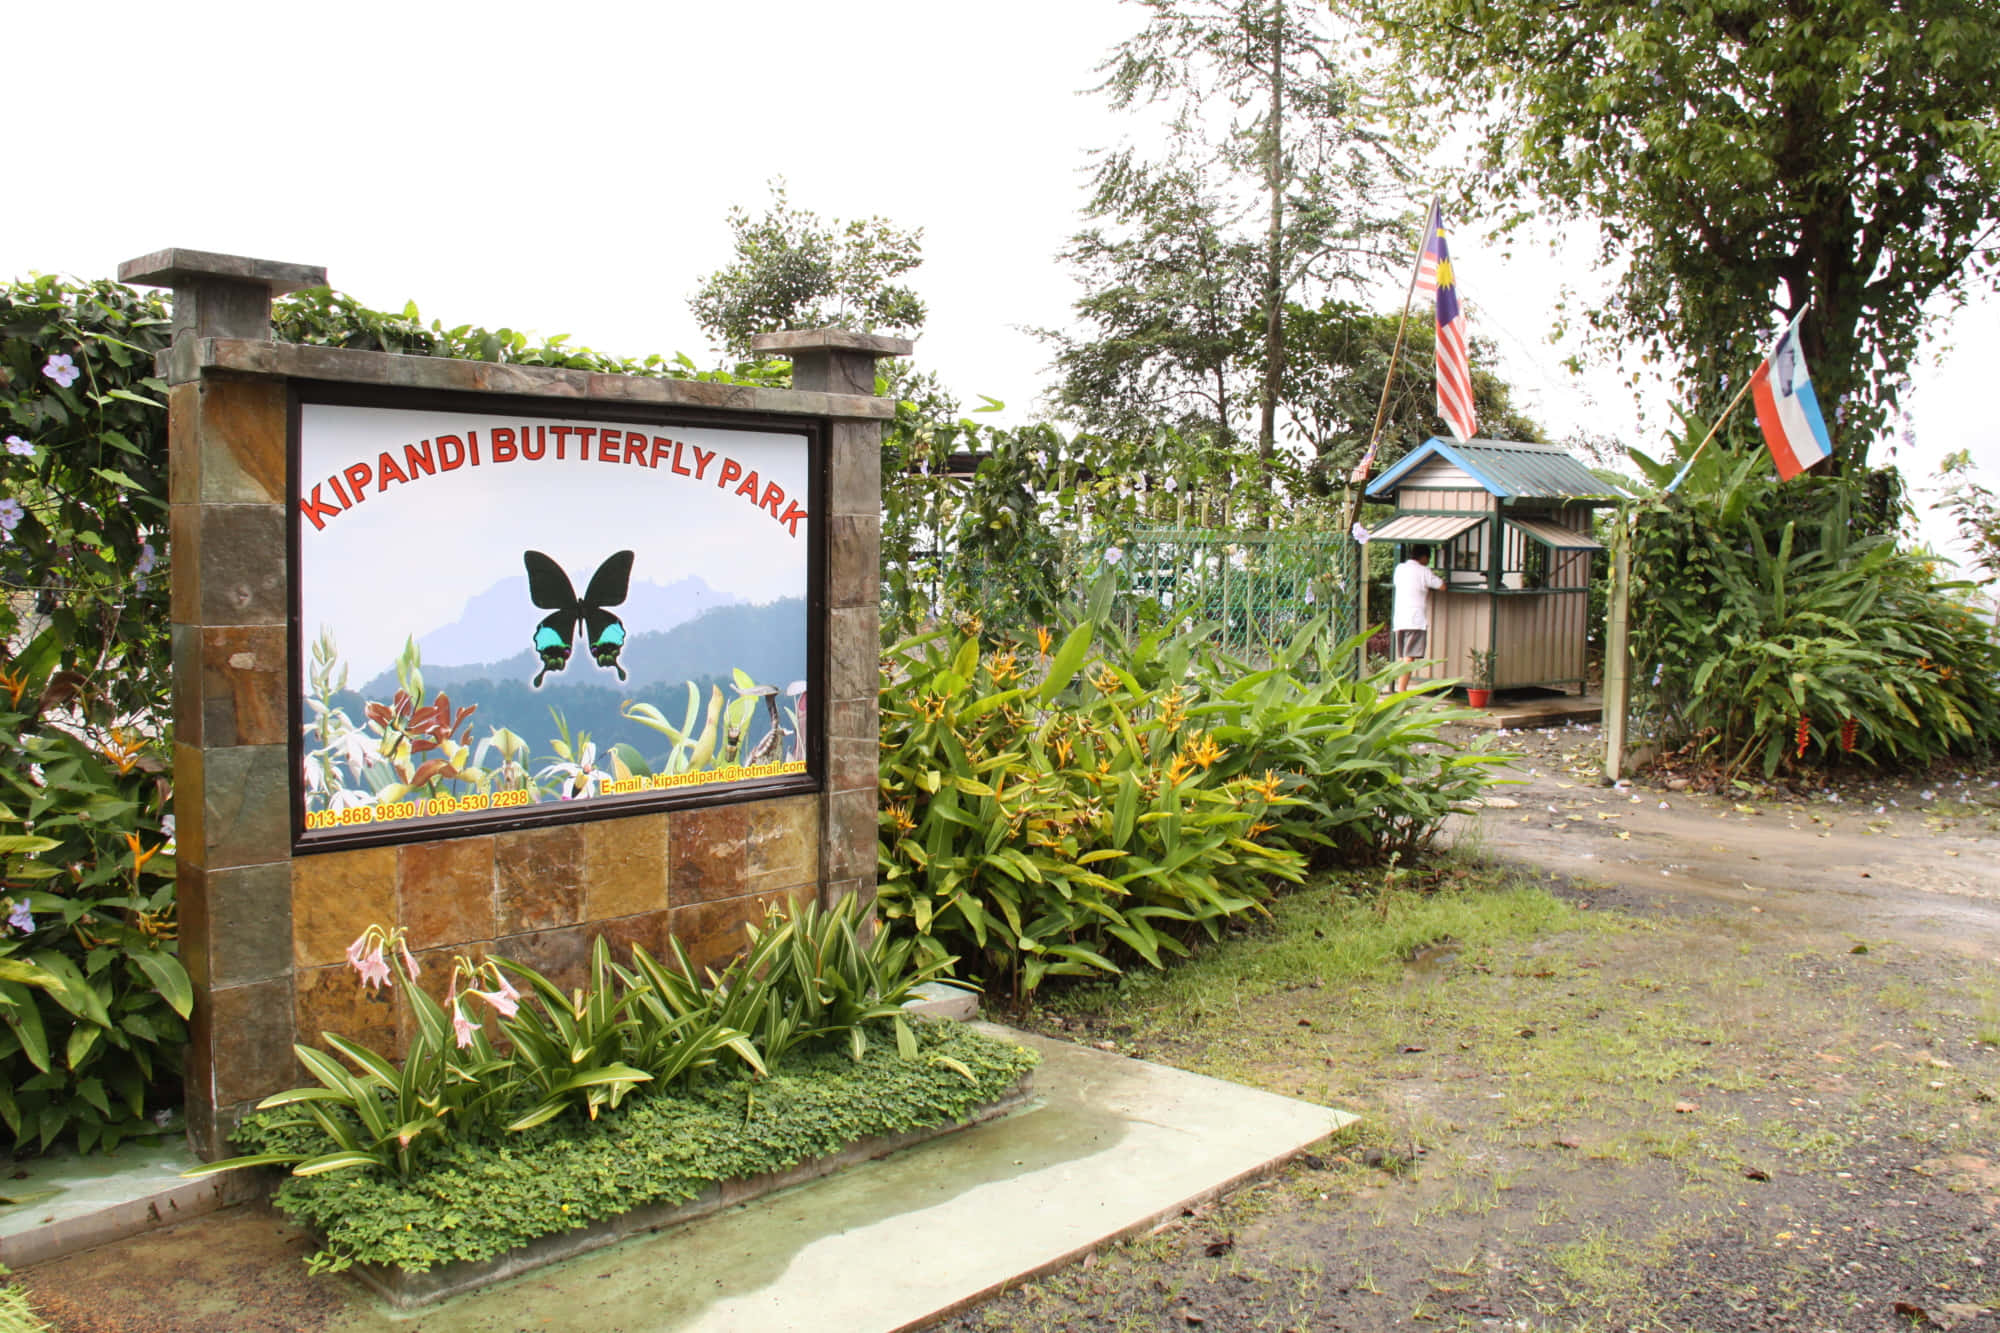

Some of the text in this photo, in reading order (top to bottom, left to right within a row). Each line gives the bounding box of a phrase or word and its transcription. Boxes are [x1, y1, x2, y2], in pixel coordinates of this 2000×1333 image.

[300, 425, 808, 538] KIPANDI BUTTERFLY PARK
[601, 776, 642, 794] E-mail
[653, 761, 807, 789] kipandipark@hotmail.com
[306, 790, 528, 827] 013-868 9830 / 019-530 2298
